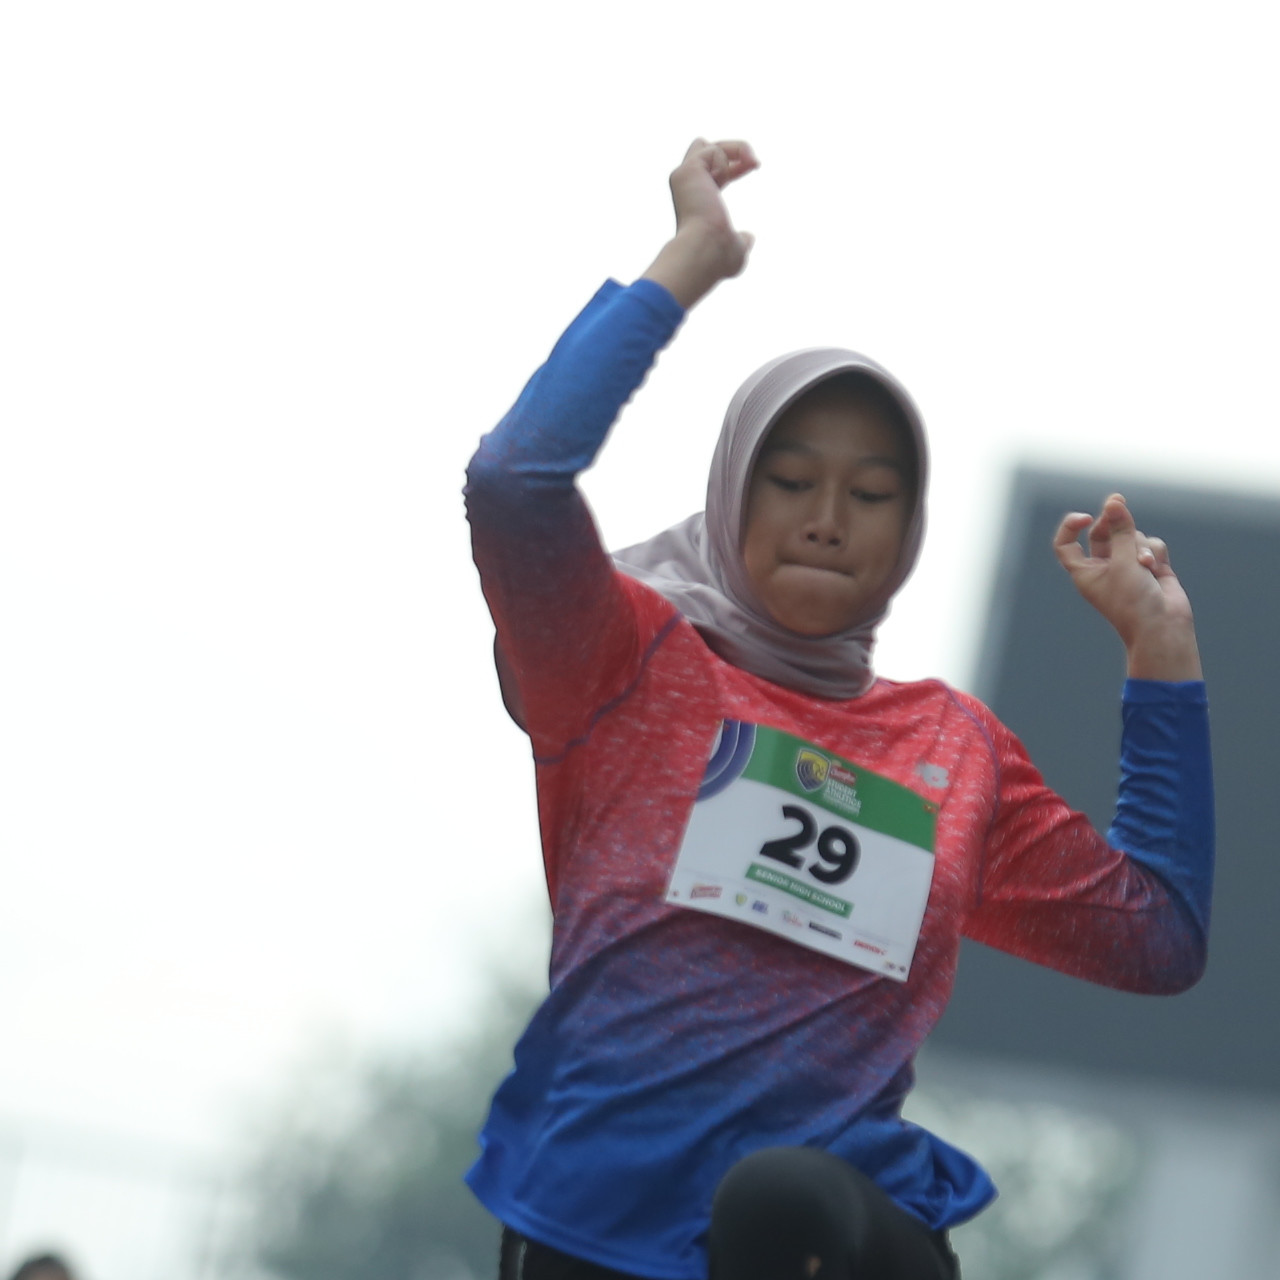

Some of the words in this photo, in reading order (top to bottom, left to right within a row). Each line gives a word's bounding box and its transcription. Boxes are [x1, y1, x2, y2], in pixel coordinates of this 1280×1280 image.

[759, 803, 861, 886] 29
[755, 868, 788, 886] SENIOR
[789, 882, 811, 898] HIGH
[811, 892, 846, 912] SCHOOL
